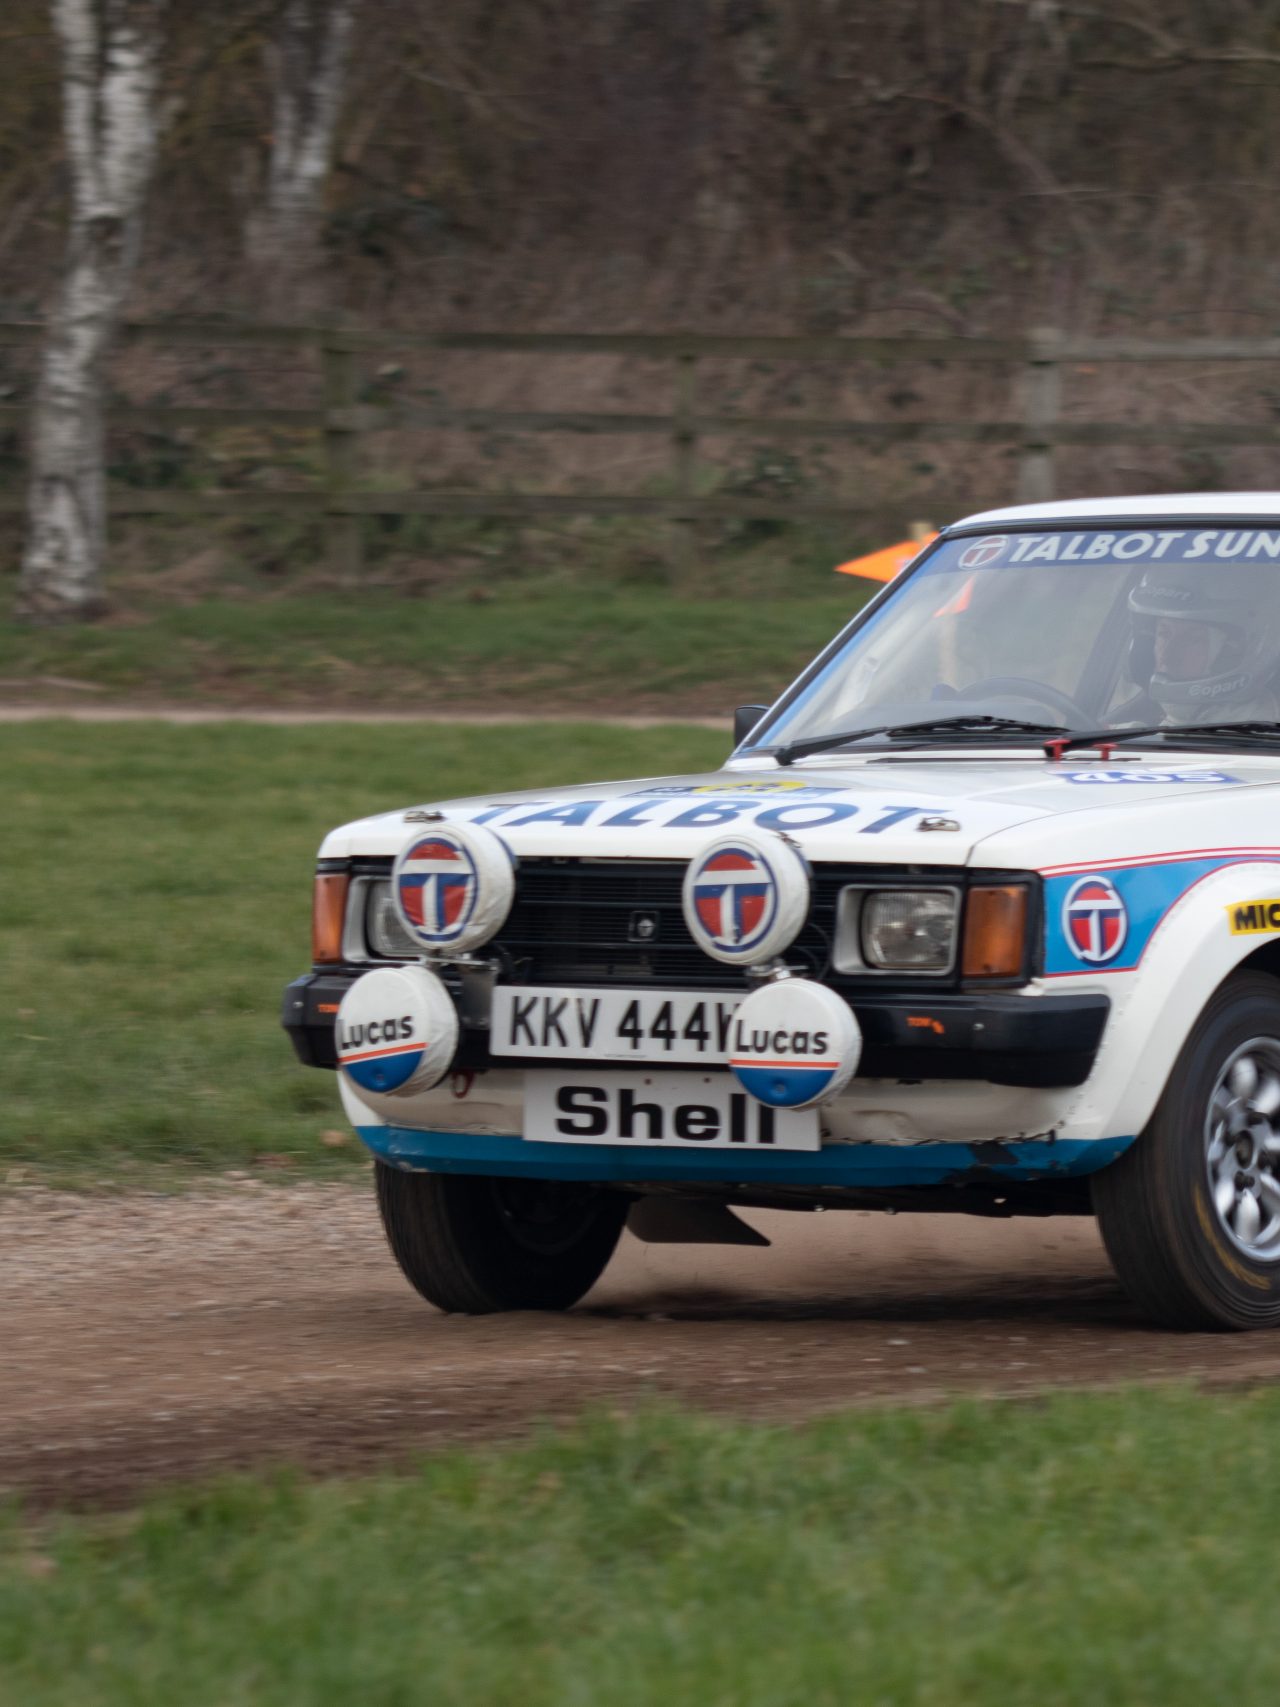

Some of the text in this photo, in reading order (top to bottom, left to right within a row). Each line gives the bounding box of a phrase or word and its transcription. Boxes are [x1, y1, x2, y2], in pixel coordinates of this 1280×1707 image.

[1008, 531, 1184, 563] TALBOT
[1072, 771, 1226, 784] 405
[470, 799, 955, 834] TALBOT
[336, 1015, 414, 1051] Lucas
[509, 995, 602, 1049] KKV
[735, 1019, 829, 1056] Lucas
[554, 1085, 776, 1144] Shell
